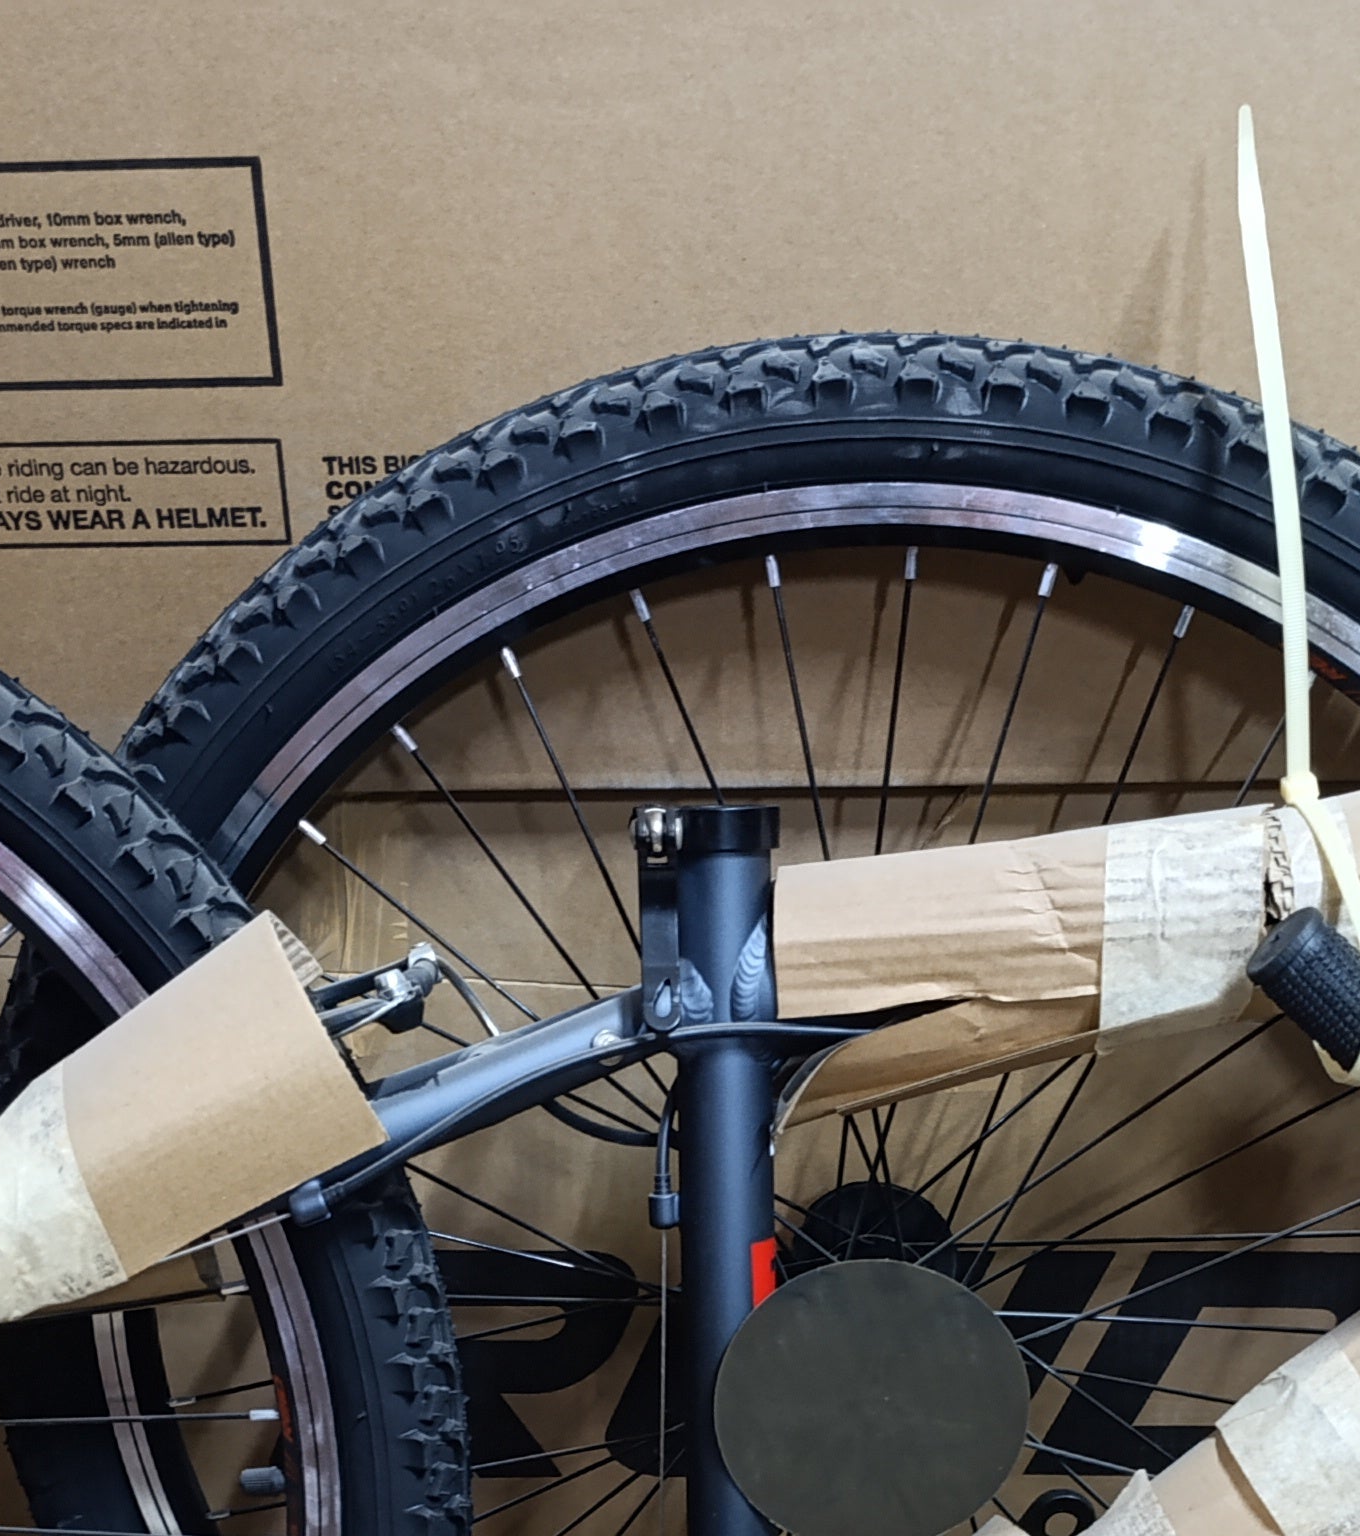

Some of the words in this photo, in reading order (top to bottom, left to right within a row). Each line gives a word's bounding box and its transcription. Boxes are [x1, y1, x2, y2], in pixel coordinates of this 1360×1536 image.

[46, 213, 90, 226] 10mm
[93, 212, 123, 225] box
[125, 210, 186, 226] wrench,
[18, 236, 46, 249] box
[50, 234, 109, 249] wrench,
[113, 234, 150, 247] 5mm
[154, 232, 194, 249] (allen
[197, 230, 235, 248] type)
[19, 256, 57, 273] type)
[60, 254, 116, 269] wrench
[1, 306, 42, 318] torque
[44, 302, 88, 315] wrench
[139, 301, 172, 313] when
[174, 300, 239, 317] tightening
[7, 459, 64, 481] riding
[70, 462, 107, 476] can
[112, 457, 139, 475] be
[144, 456, 255, 475] hazardous.
[322, 456, 377, 474] THIS
[6, 486, 45, 503] ride
[51, 486, 71, 503] at
[76, 484, 131, 506] night.
[46, 509, 125, 530] WEAR
[132, 508, 151, 529] A
[156, 507, 266, 529] HELMET.
